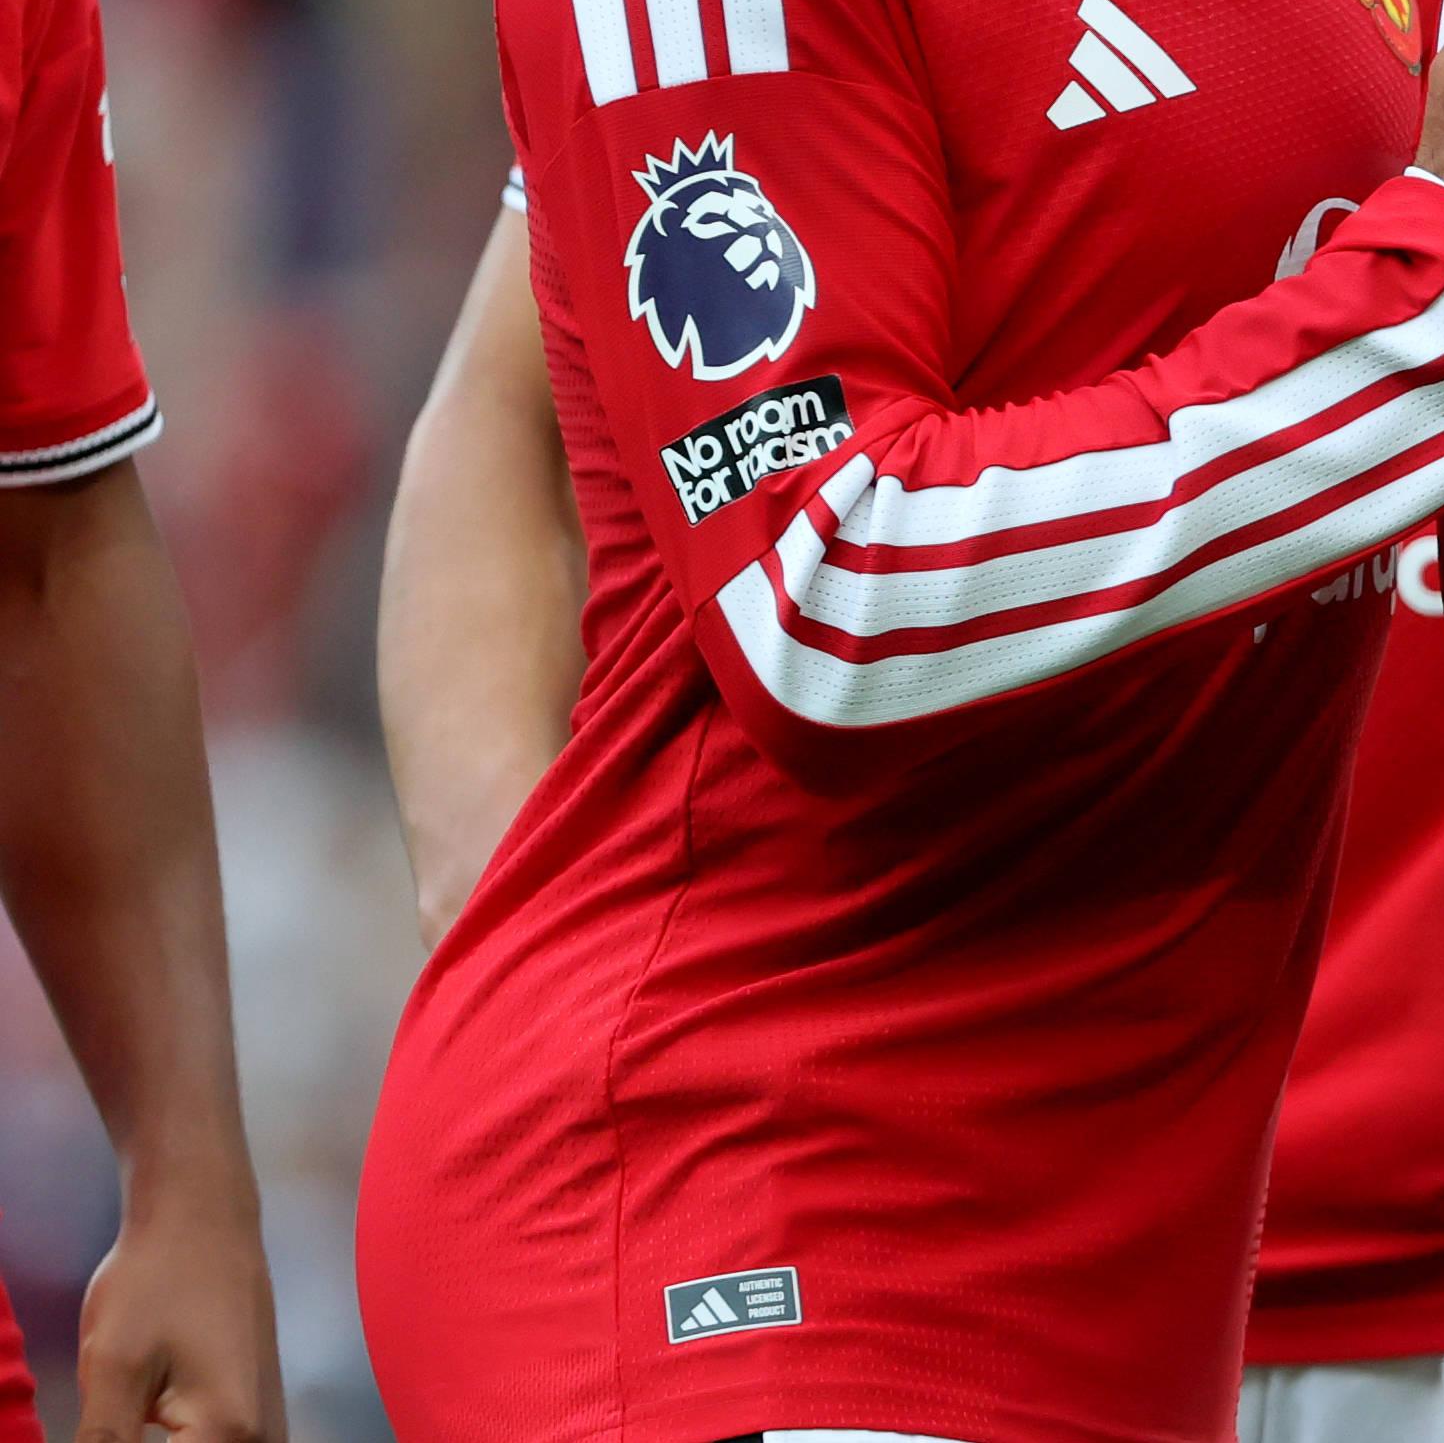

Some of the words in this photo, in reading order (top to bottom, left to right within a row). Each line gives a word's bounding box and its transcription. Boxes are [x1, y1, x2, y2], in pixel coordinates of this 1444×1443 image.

[660, 435, 723, 489] No
[723, 390, 827, 455] room
[678, 466, 733, 524] for
[736, 422, 854, 491] racism
[738, 1277, 784, 1293] AUTHENTIC
[745, 1291, 785, 1305] LICENSED
[748, 1304, 786, 1319] PRODUCT
